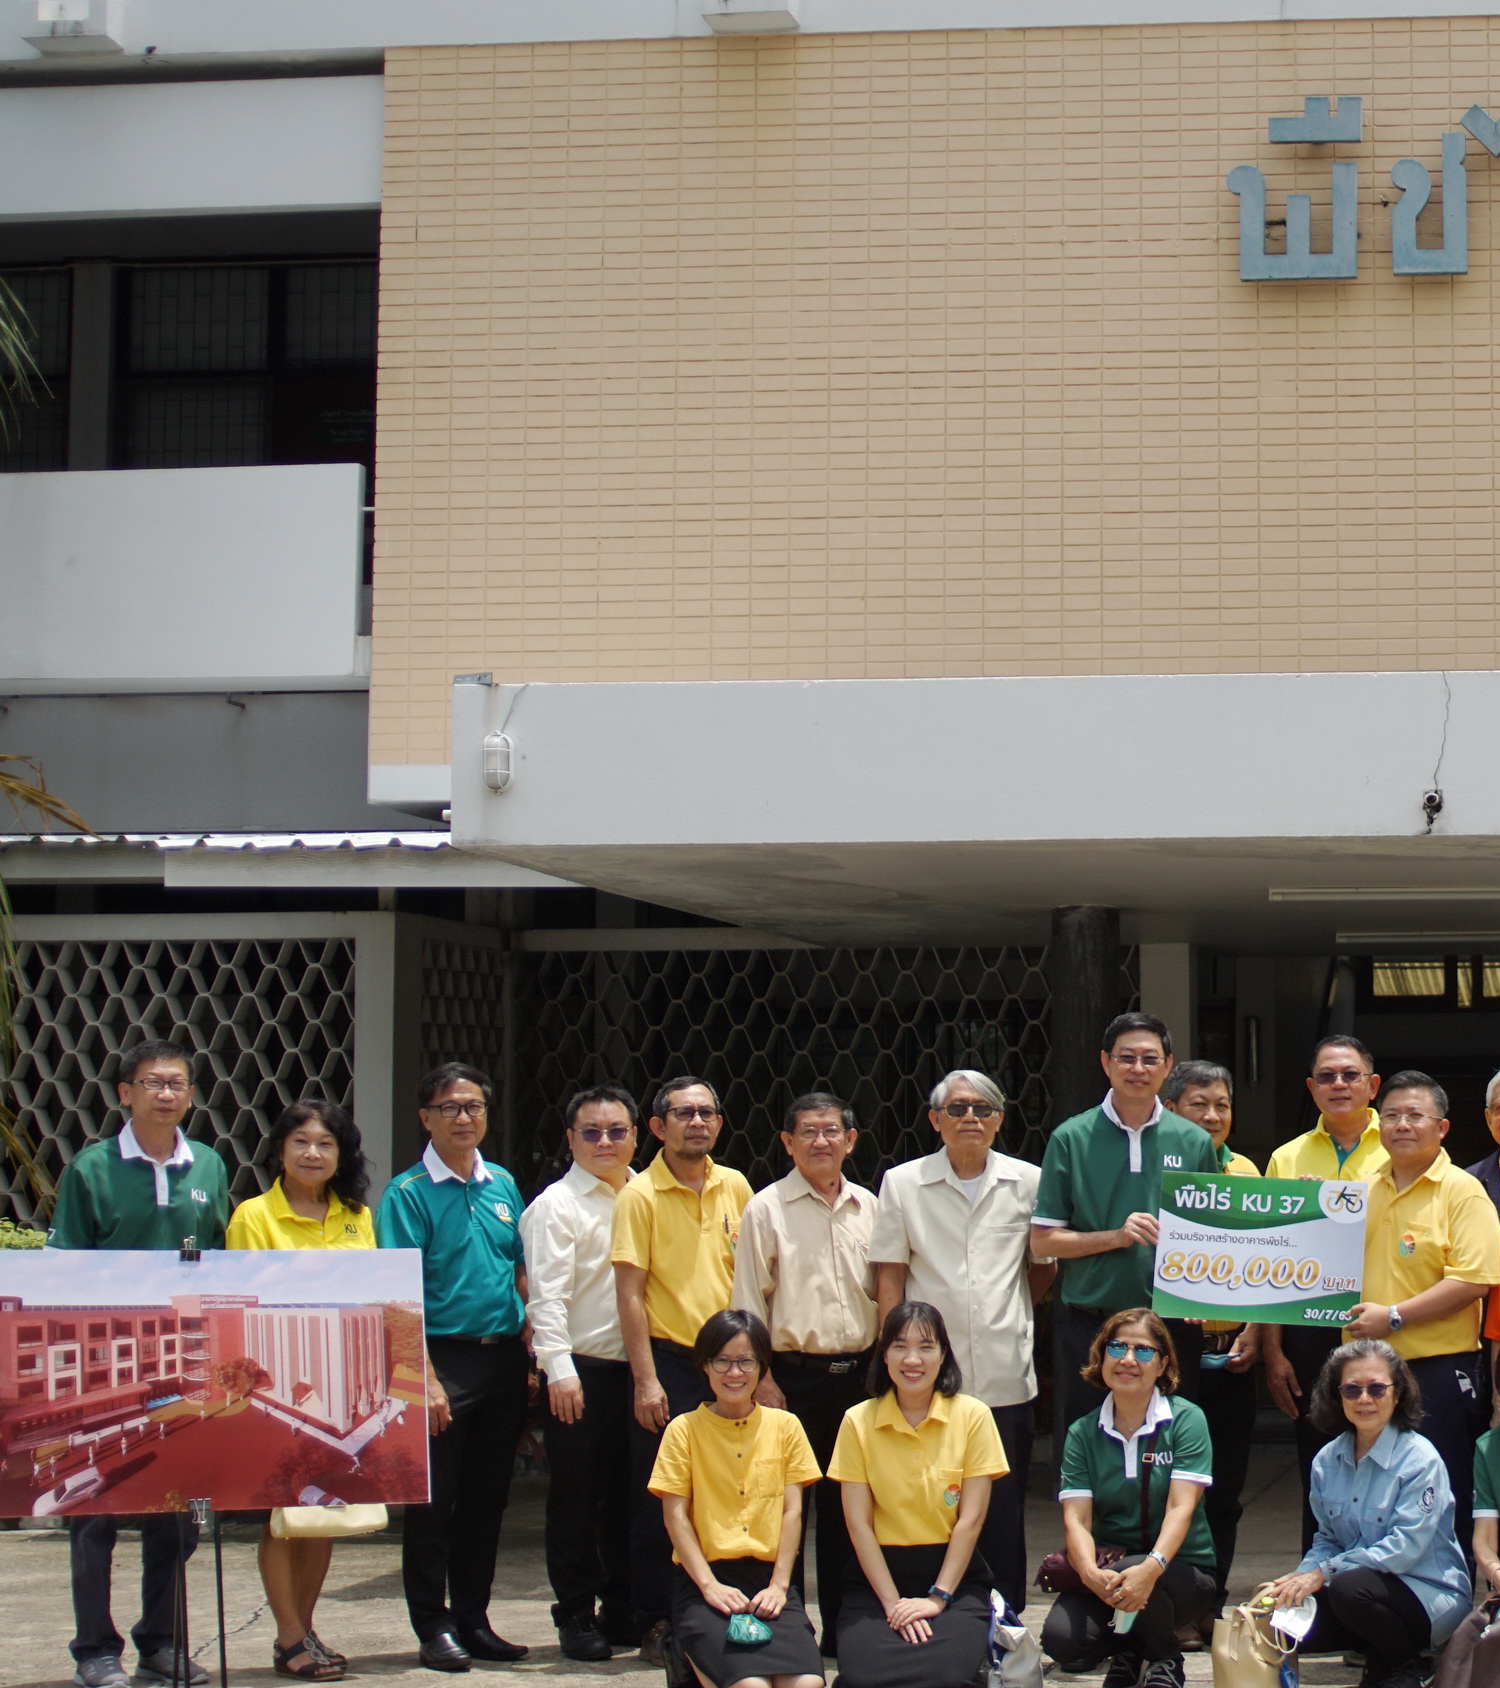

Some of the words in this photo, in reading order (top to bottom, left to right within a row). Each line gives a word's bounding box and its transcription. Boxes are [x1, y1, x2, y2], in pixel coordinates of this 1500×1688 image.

[1163, 1154, 1183, 1168] KU
[191, 1187, 206, 1202] KU
[1174, 1183, 1231, 1211] พืชไร่
[1241, 1193, 1272, 1213] KU
[1278, 1195, 1306, 1215] 37
[494, 1202, 509, 1217] KU
[344, 1222, 358, 1234] KU
[1159, 1249, 1321, 1290] 800,000
[1324, 1275, 1358, 1291] บาท
[1154, 1450, 1173, 1466] KU
